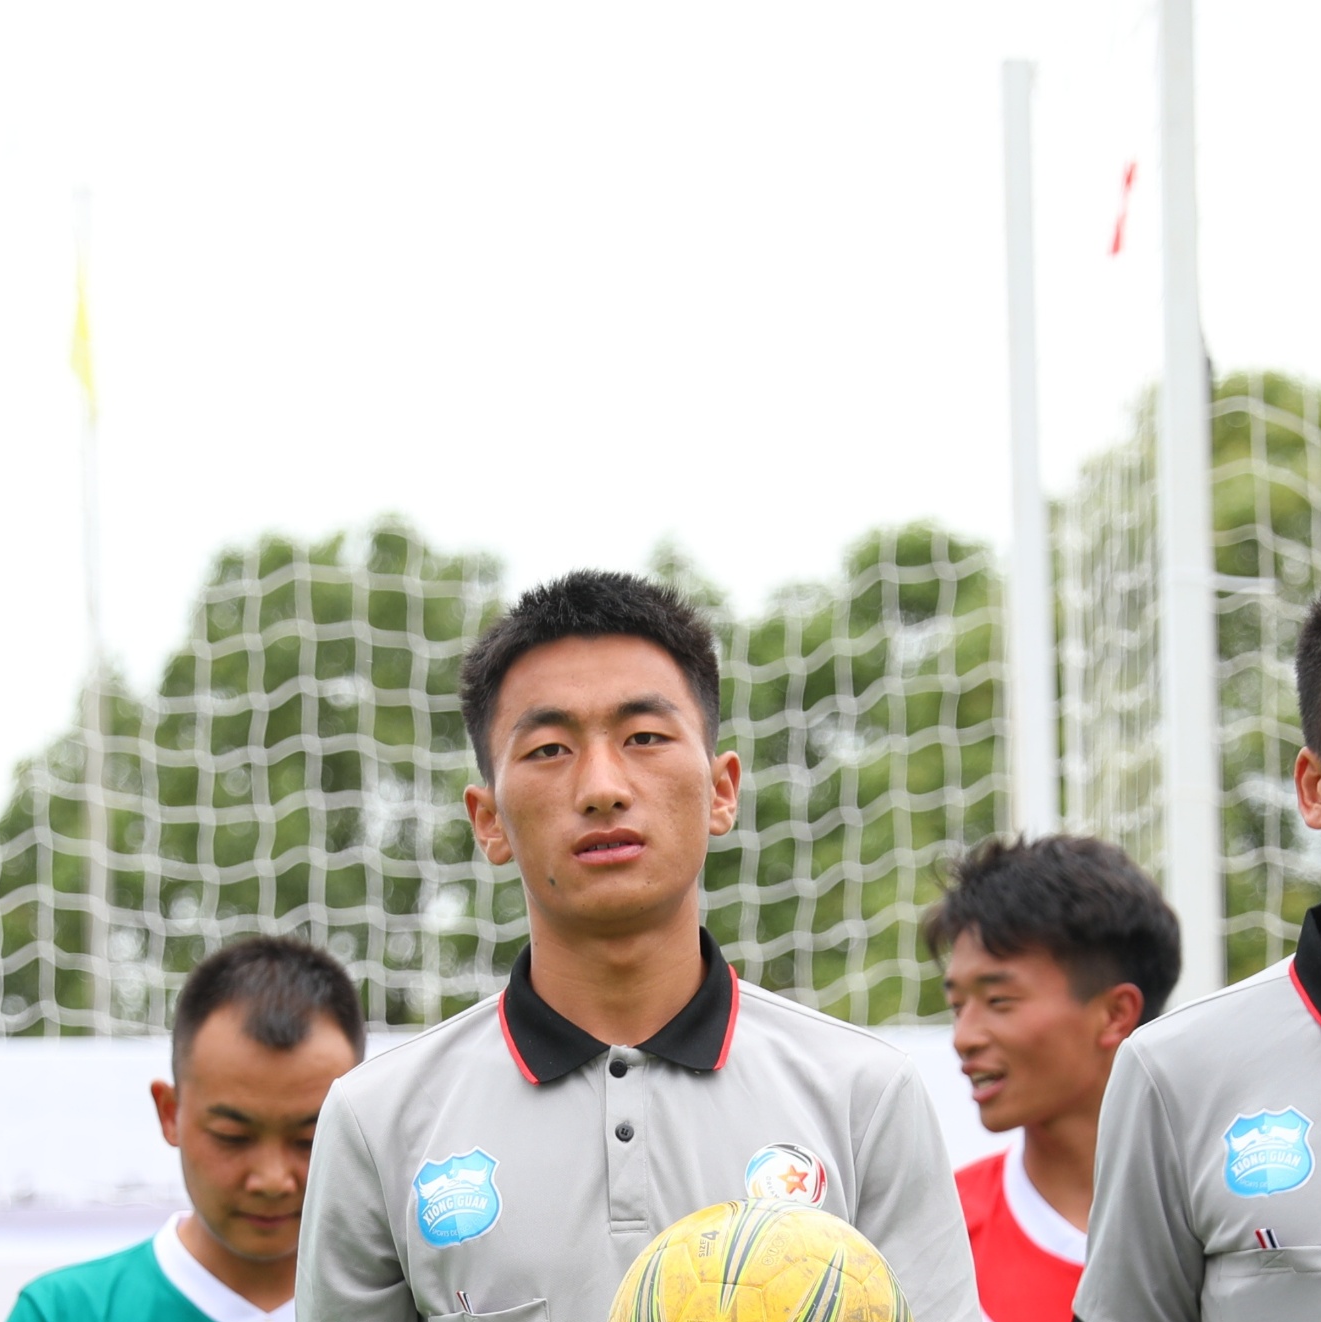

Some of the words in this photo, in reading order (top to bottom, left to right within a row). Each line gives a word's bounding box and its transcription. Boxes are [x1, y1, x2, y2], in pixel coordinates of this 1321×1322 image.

[1231, 1151, 1266, 1178] XIONG
[1269, 1151, 1302, 1168] GUAN
[422, 1197, 454, 1226] XIONG
[457, 1195, 489, 1211] GUAN
[701, 1230, 720, 1241] 4
[698, 1239, 707, 1258] SIZE
